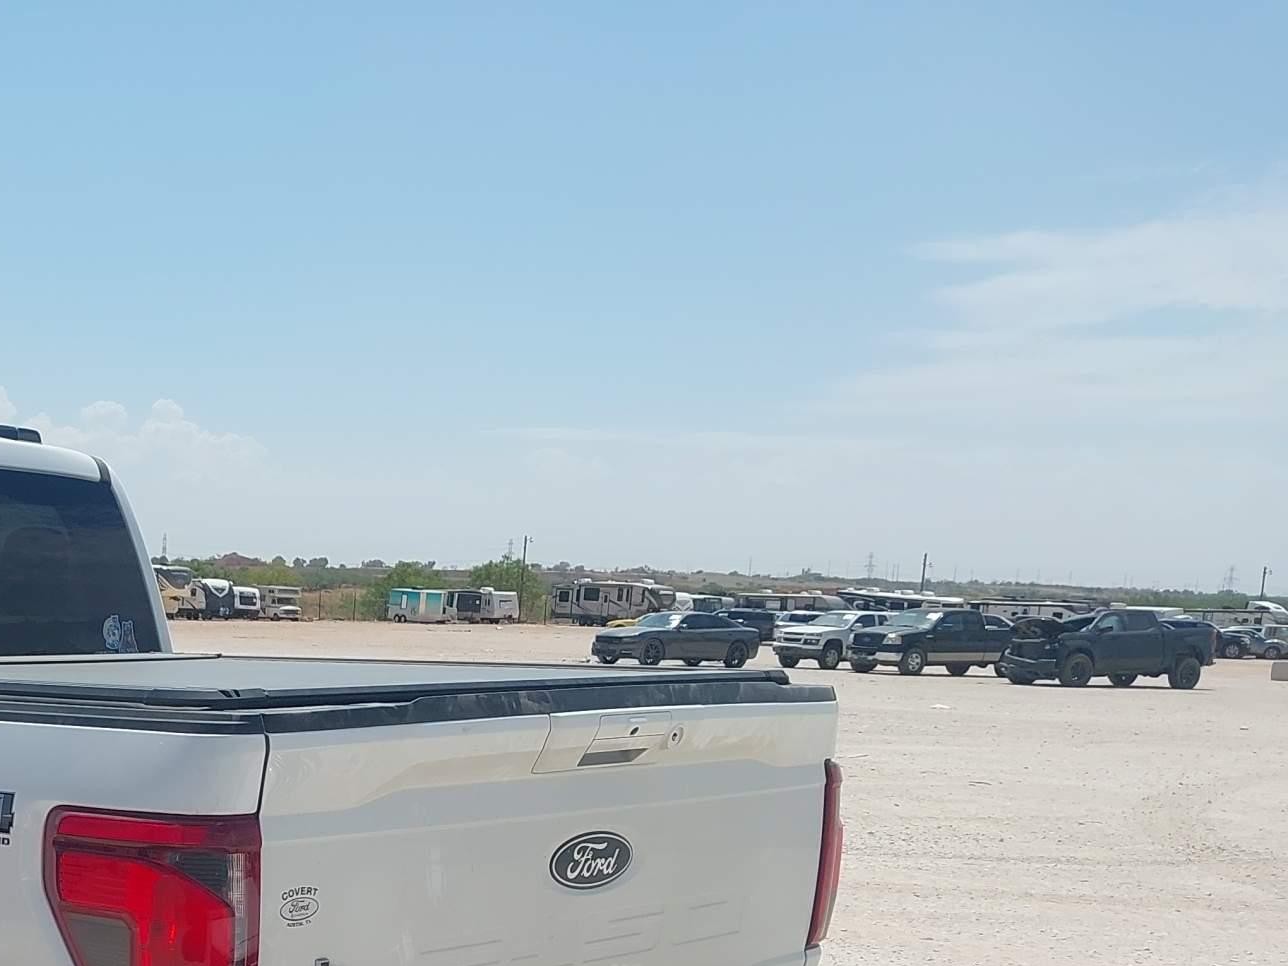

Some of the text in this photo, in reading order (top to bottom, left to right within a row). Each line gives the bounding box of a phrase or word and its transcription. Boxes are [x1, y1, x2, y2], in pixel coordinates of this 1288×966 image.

[566, 842, 620, 879] Ford
[281, 886, 319, 901] COVERT
[288, 900, 311, 914] Ford
